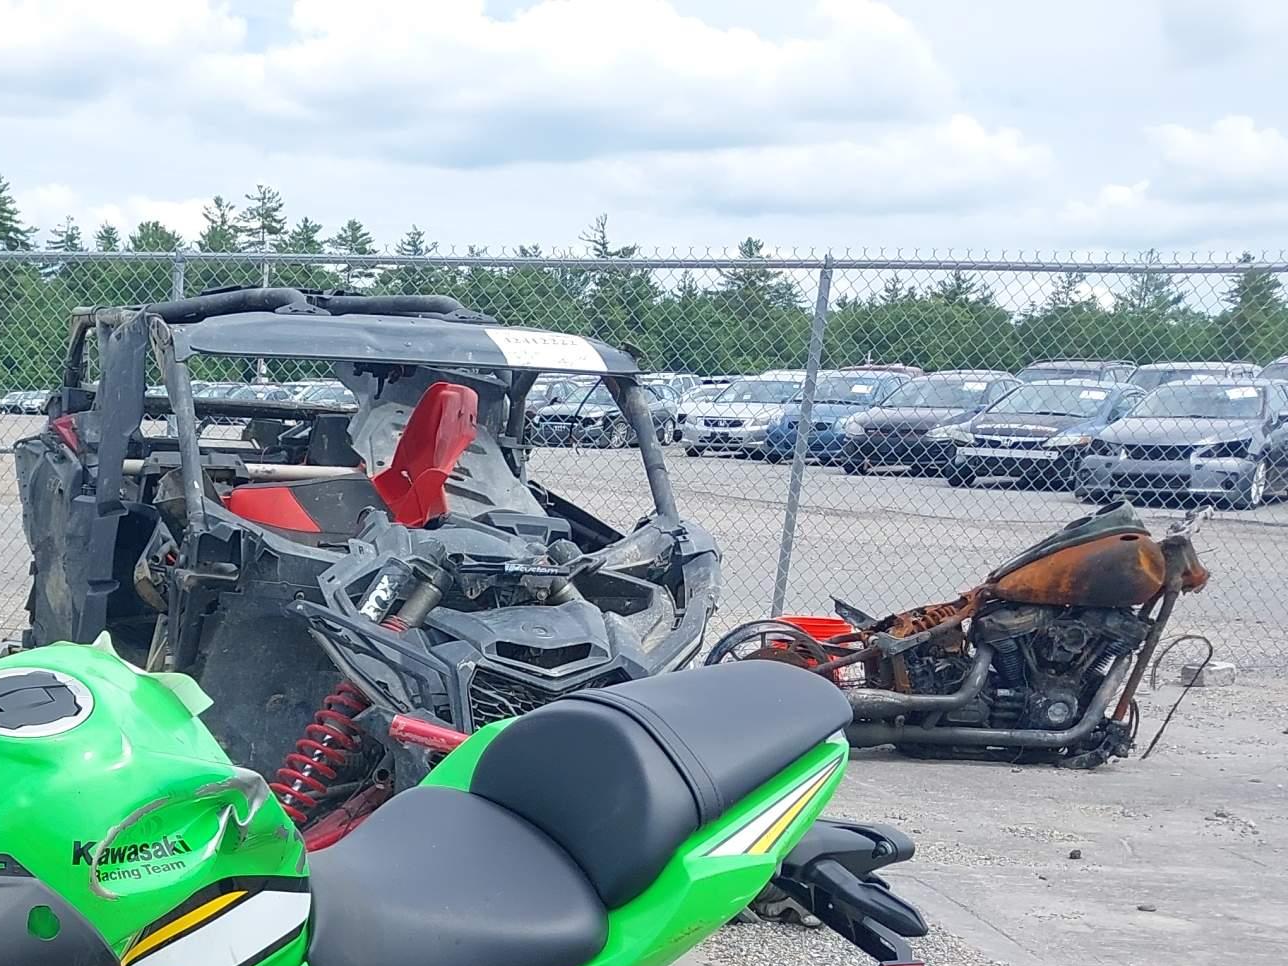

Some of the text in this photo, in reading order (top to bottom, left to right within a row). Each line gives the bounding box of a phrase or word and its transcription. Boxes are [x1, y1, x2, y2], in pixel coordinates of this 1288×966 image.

[359, 574, 391, 621] FOX
[72, 835, 192, 866] Kawasaki
[89, 860, 186, 882] Racing Team
